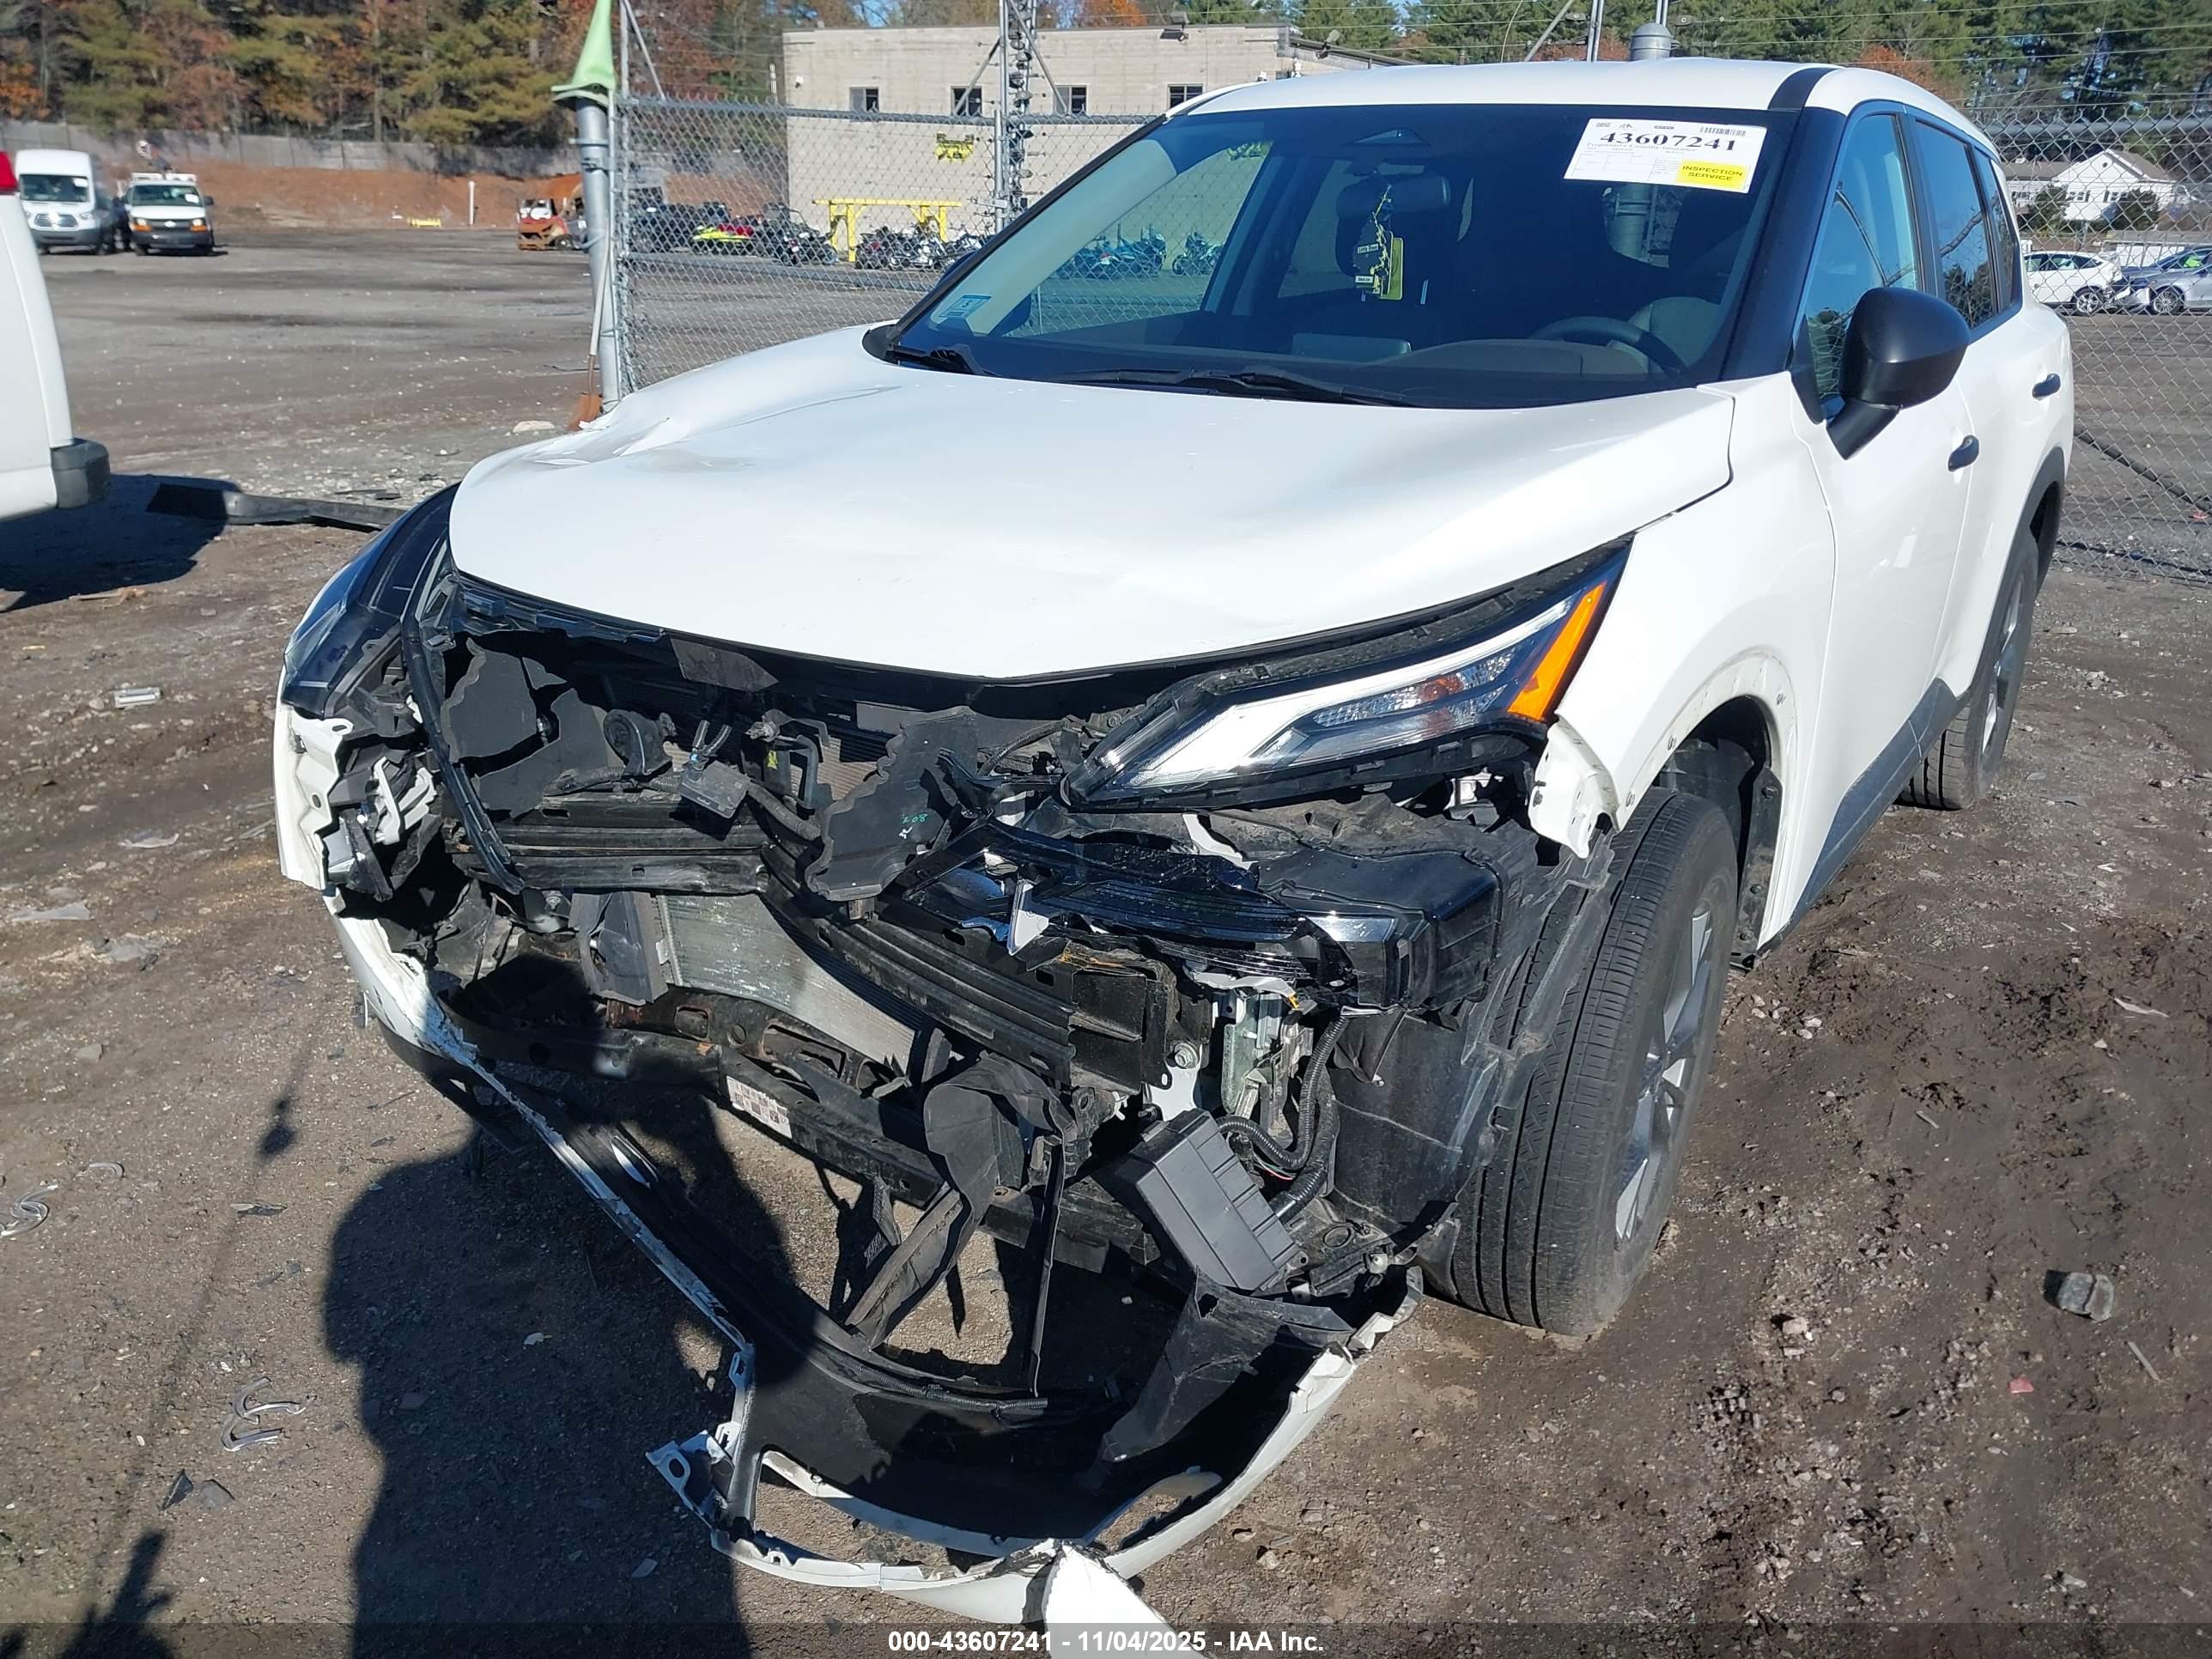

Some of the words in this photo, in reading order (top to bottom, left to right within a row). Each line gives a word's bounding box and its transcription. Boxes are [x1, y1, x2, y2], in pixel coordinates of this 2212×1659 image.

[1601, 131, 1736, 151] 43607241
[1682, 166, 1743, 177] INSPECTION
[1688, 172, 1733, 181] SERVICE
